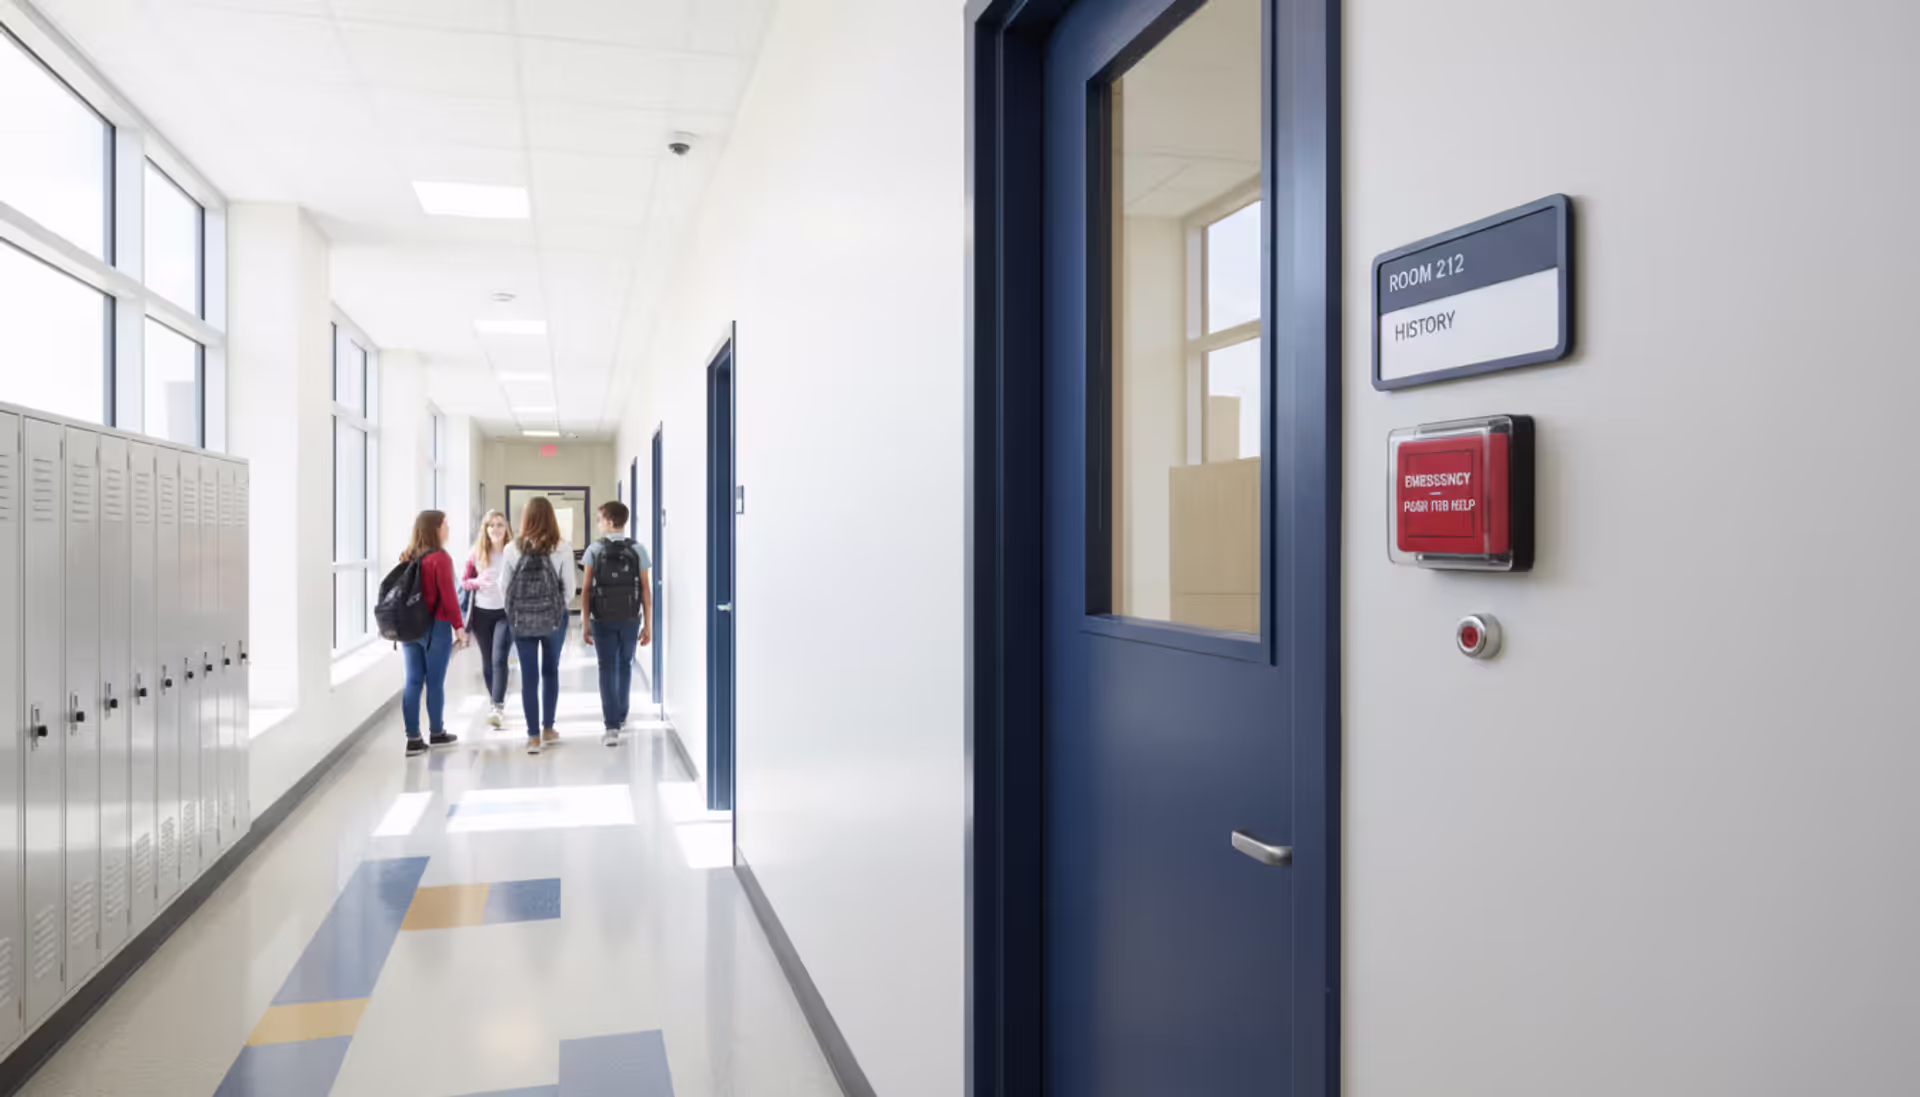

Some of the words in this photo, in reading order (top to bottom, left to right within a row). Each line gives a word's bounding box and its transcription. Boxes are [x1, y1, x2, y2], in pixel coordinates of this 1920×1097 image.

[1389, 263, 1432, 292] ROOM
[1436, 253, 1464, 278] 212
[1395, 310, 1456, 341] HISTORY
